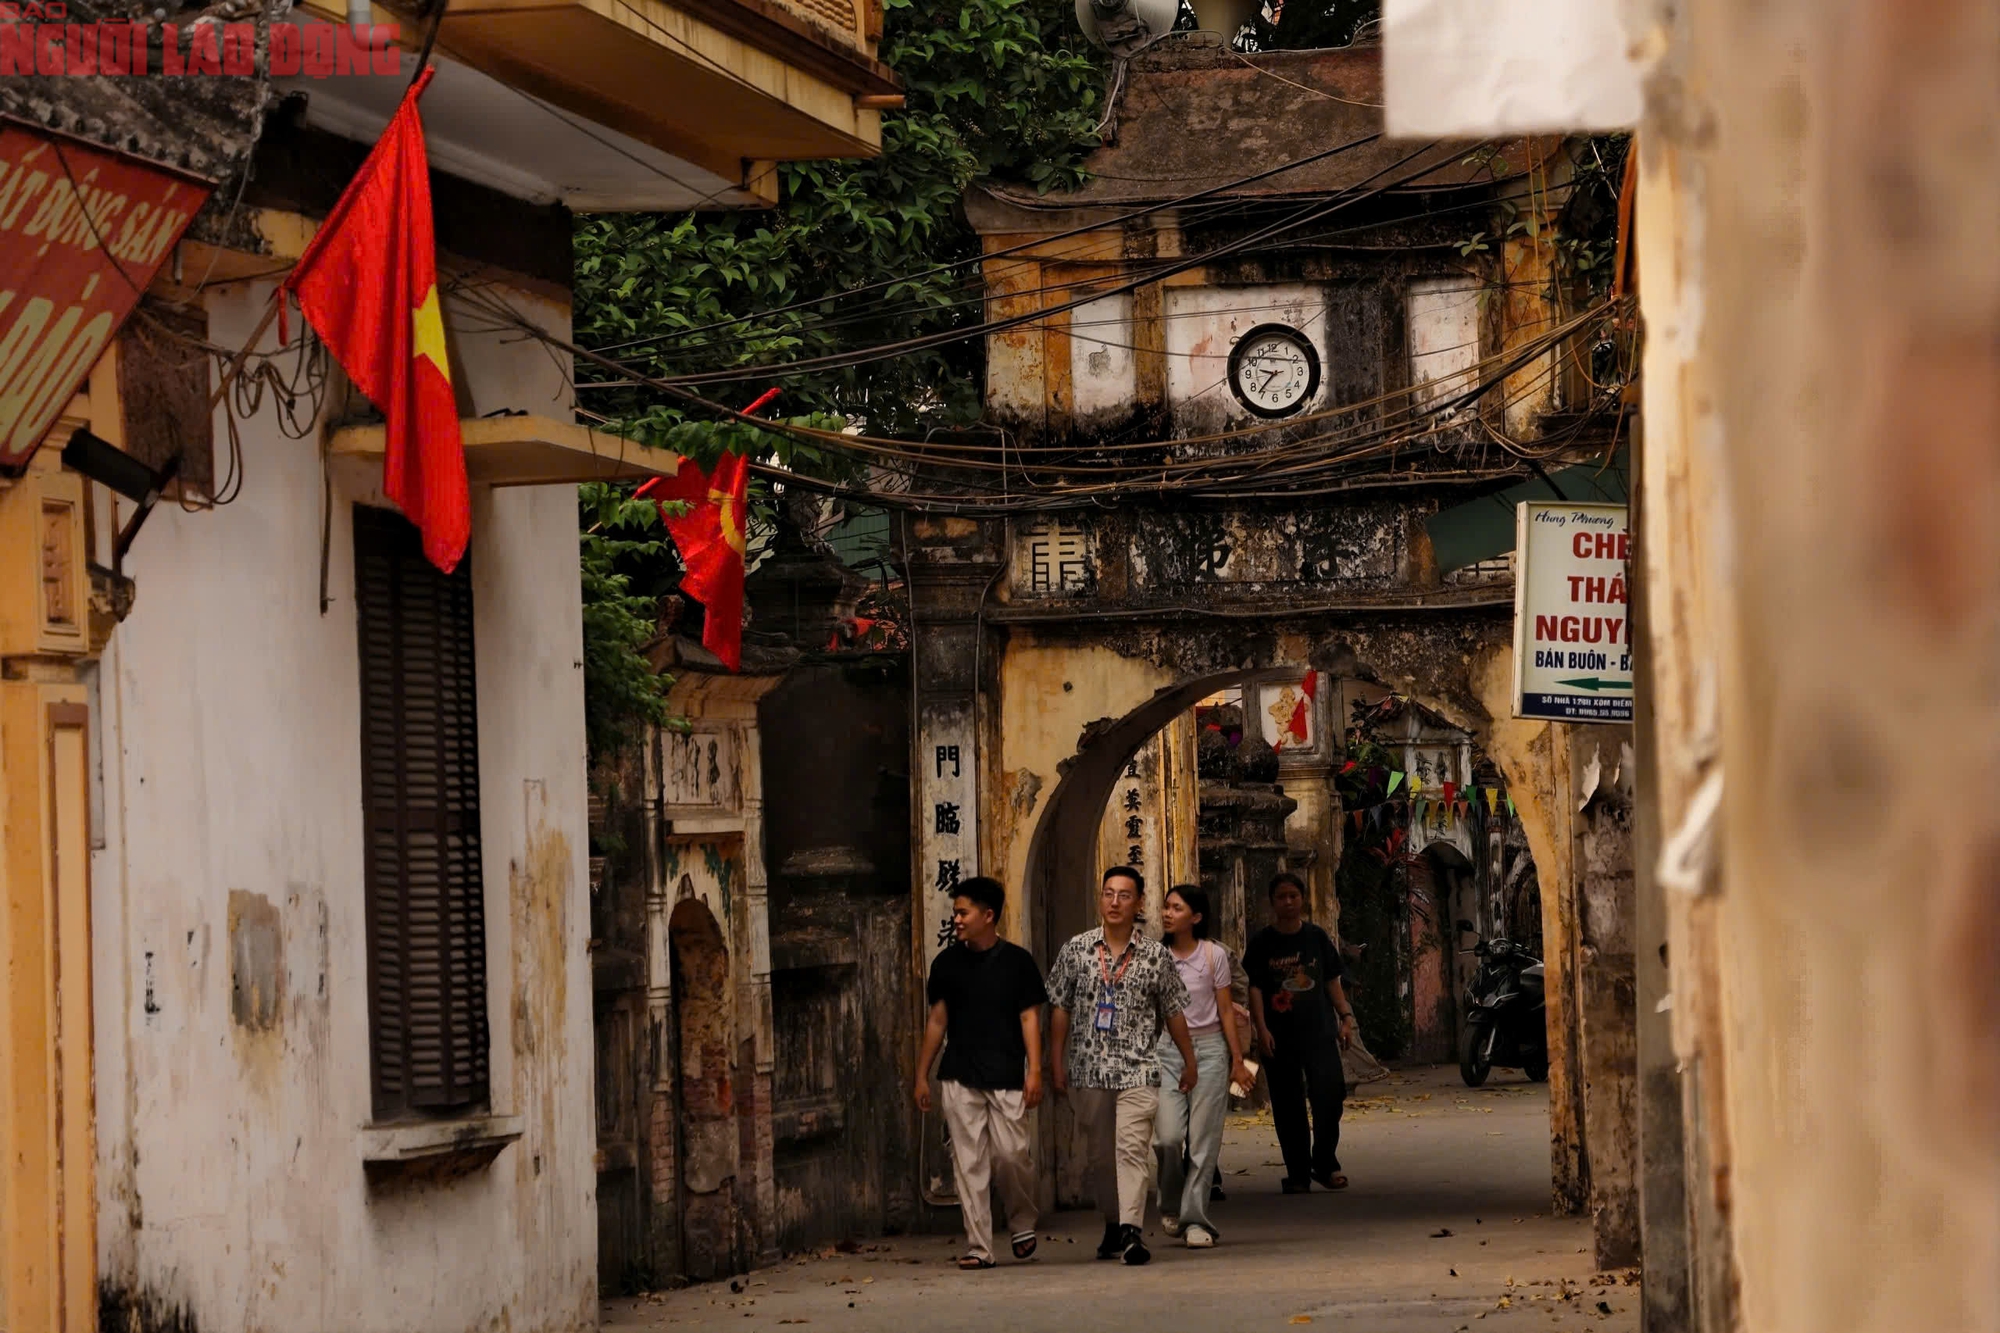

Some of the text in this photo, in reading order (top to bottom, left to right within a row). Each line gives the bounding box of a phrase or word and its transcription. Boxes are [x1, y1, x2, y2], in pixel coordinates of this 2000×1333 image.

[1245, 369, 1251, 379] 9
[1297, 367, 1303, 376] 3
[1250, 382, 1257, 392] 8
[1294, 380, 1300, 389] 4
[1272, 394, 1278, 403] 6
[1285, 389, 1292, 398] 5
[1567, 572, 1627, 604] THÁ
[1535, 615, 1628, 645] NGUY
[1535, 647, 1564, 668] BÁN
[1568, 649, 1606, 670] BUÔN
